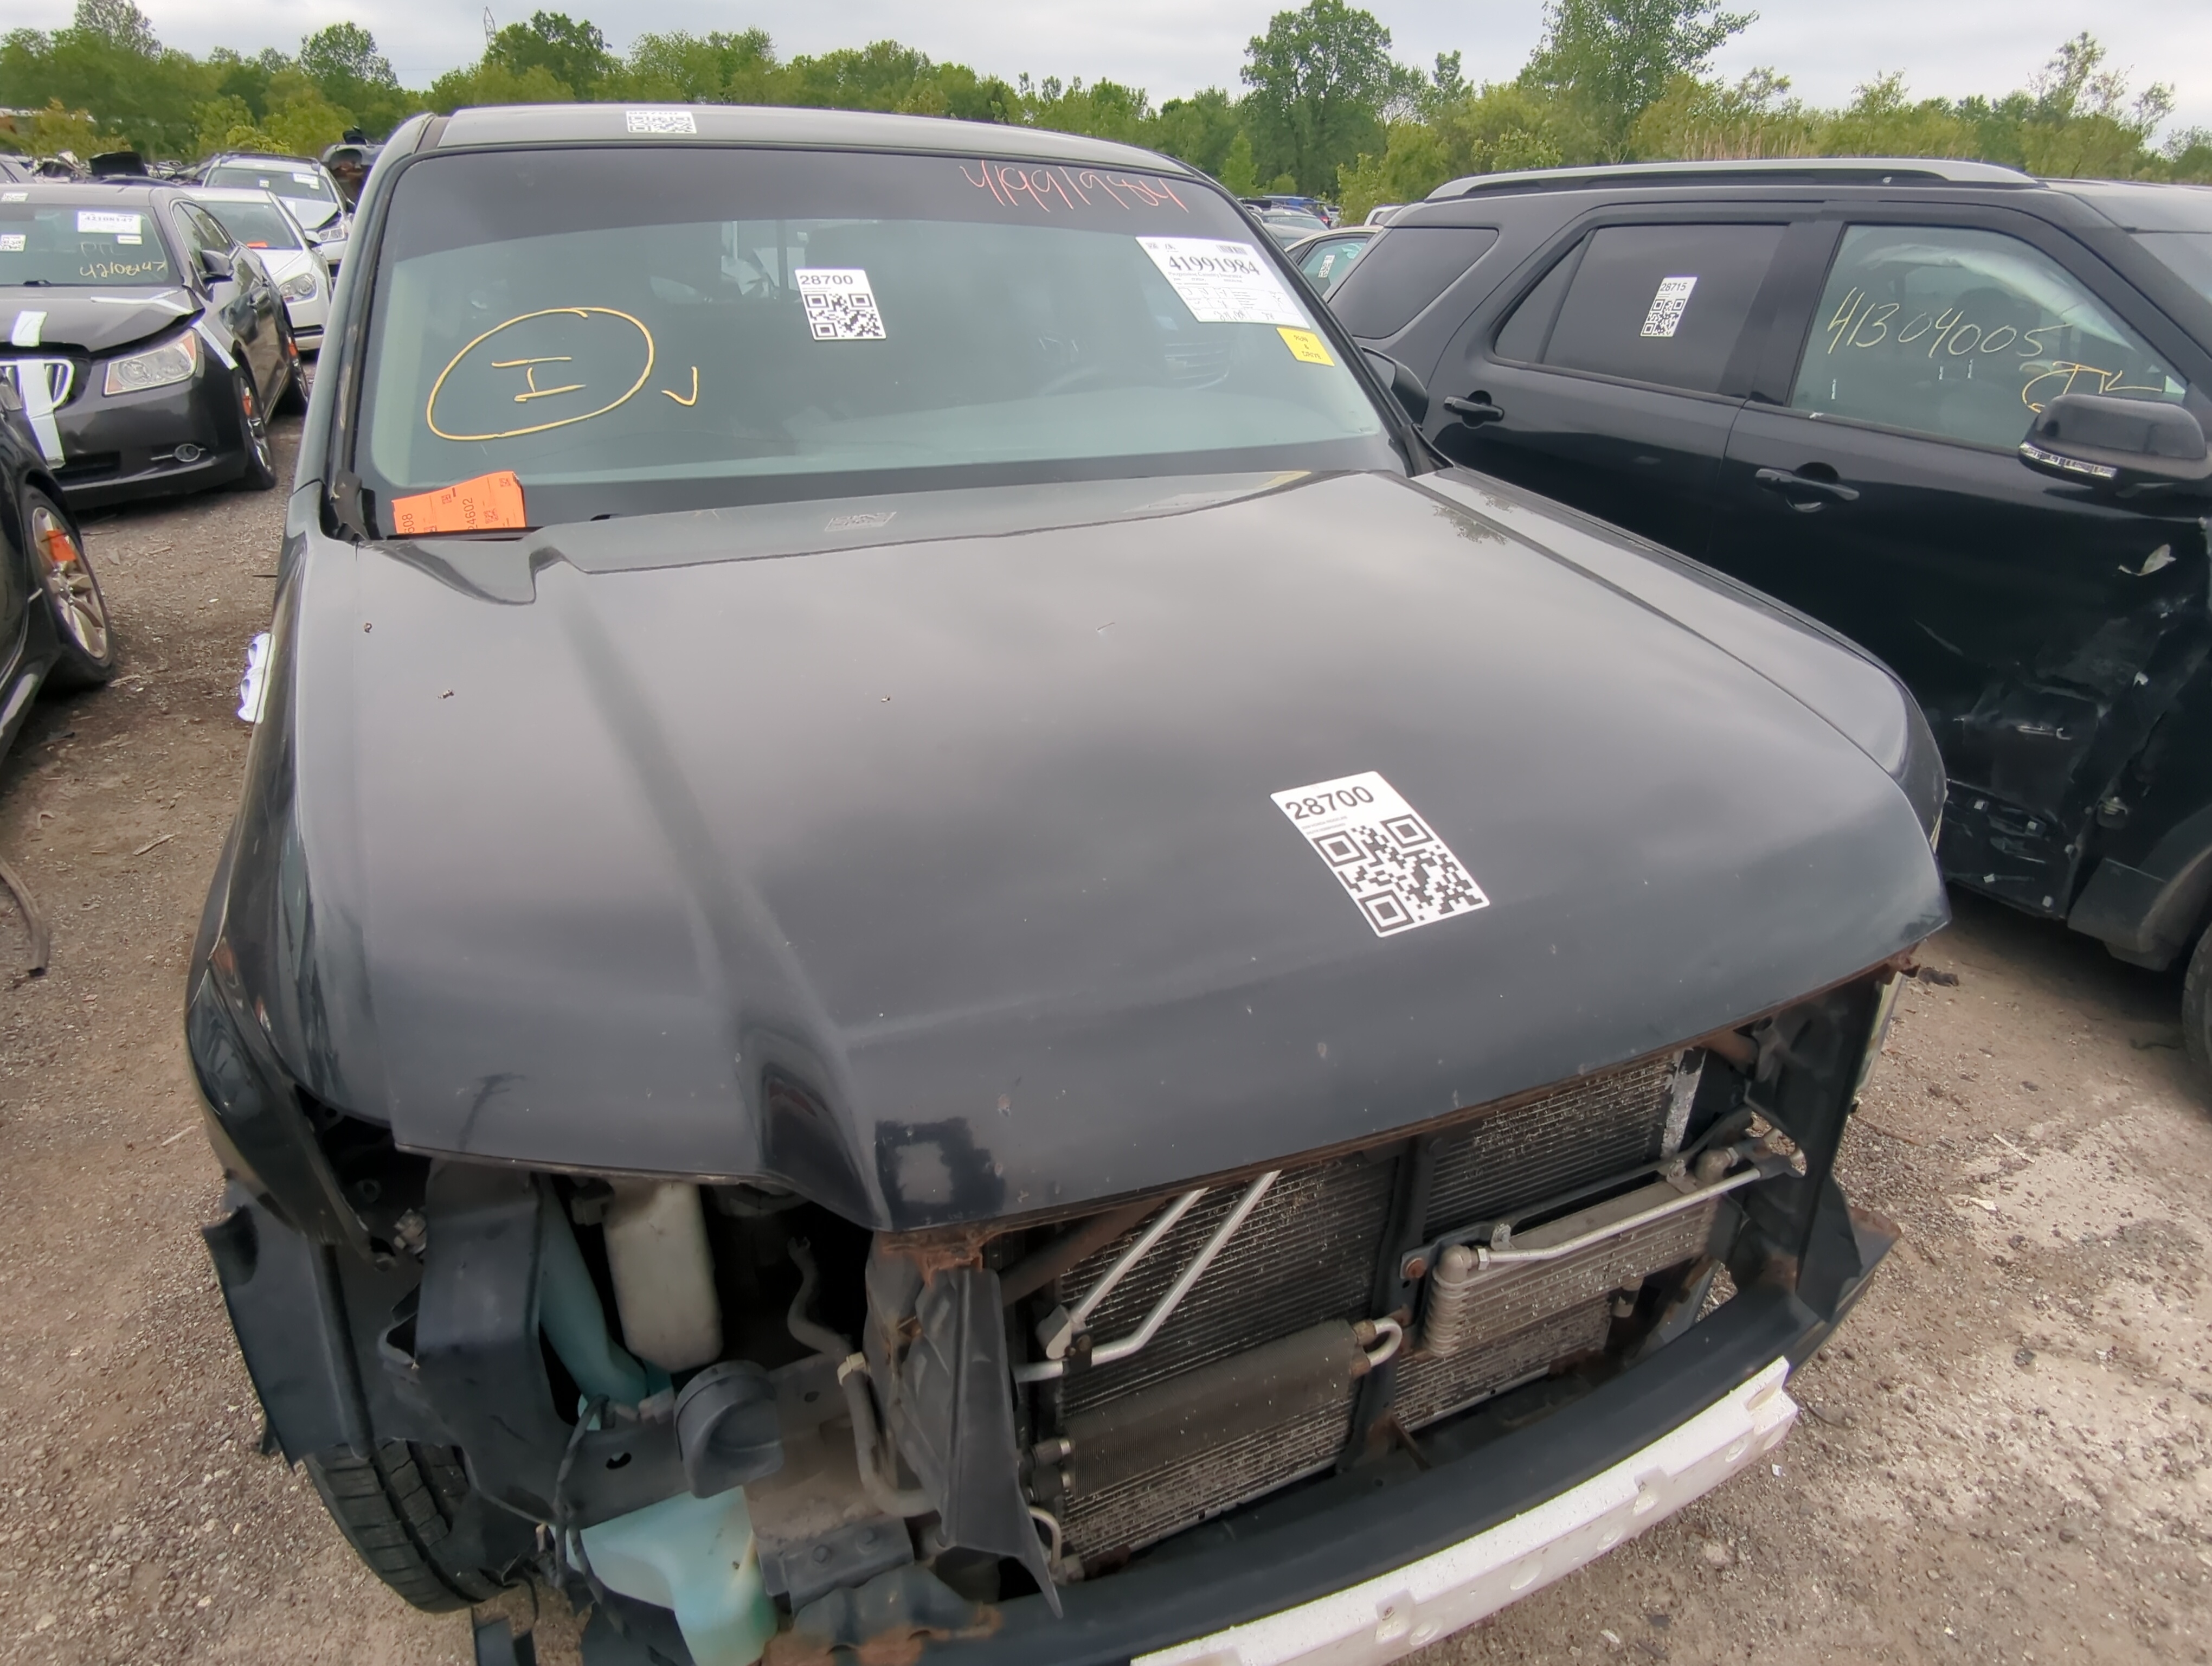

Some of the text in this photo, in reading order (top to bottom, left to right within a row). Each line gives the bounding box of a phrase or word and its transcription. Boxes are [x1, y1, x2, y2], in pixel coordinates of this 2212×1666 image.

[959, 159, 1189, 212] 41991984
[80, 261, 165, 279] 42108147
[1169, 255, 1261, 275] 41991984
[800, 275, 853, 285] 28700
[1660, 283, 1687, 291] 28715
[1828, 286, 2073, 358] 41304005
[1285, 786, 1374, 819] 28700
